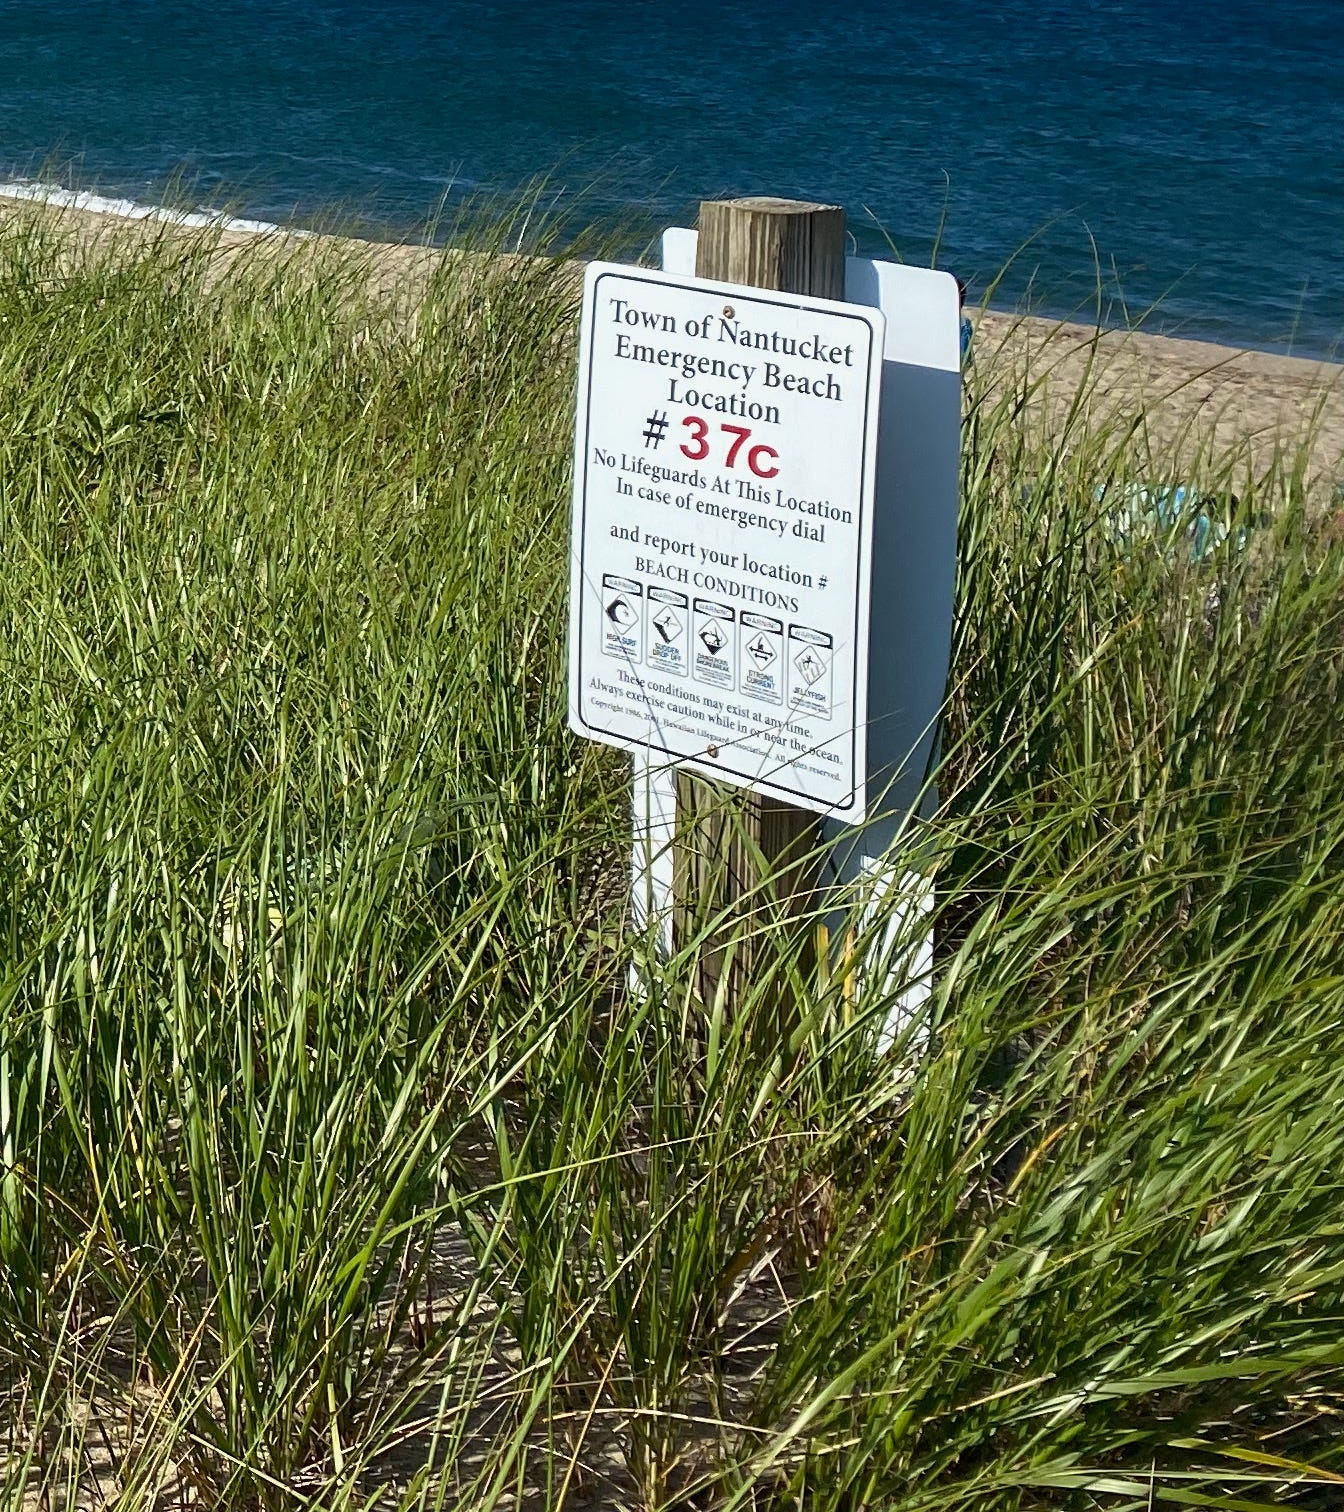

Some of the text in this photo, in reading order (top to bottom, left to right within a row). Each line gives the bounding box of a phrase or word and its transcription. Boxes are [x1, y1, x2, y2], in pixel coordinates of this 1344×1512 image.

[610, 299, 853, 367] Town of Nantucket
[615, 334, 843, 401] Emergency Beach
[667, 379, 781, 424] Location
[593, 448, 852, 524] No Lifeguards At This Location
[616, 477, 635, 496] In
[638, 485, 671, 504] case
[675, 491, 693, 509] of
[696, 501, 788, 537] emergency
[792, 518, 825, 543] dial
[610, 523, 639, 543] and
[645, 534, 696, 557] report
[700, 547, 739, 569] your
[743, 554, 813, 588] location
[634, 557, 799, 613] BEACH CONDITIONS
[589, 677, 624, 697] Always
[626, 691, 665, 708] exercise
[667, 702, 705, 720] caution
[708, 712, 735, 730] while
[737, 722, 747, 734] in
[750, 729, 760, 737] or
[764, 732, 786, 746] near
[790, 739, 807, 752] the
[617, 669, 645, 688] These
[648, 681, 701, 703] conditions
[703, 698, 724, 713] may
[726, 704, 750, 718] exist
[752, 712, 762, 722] at
[590, 697, 624, 713] Copyright
[663, 719, 695, 733] Hawaiian
[697, 729, 730, 742] Lifeguard
[775, 754, 785, 762] All
